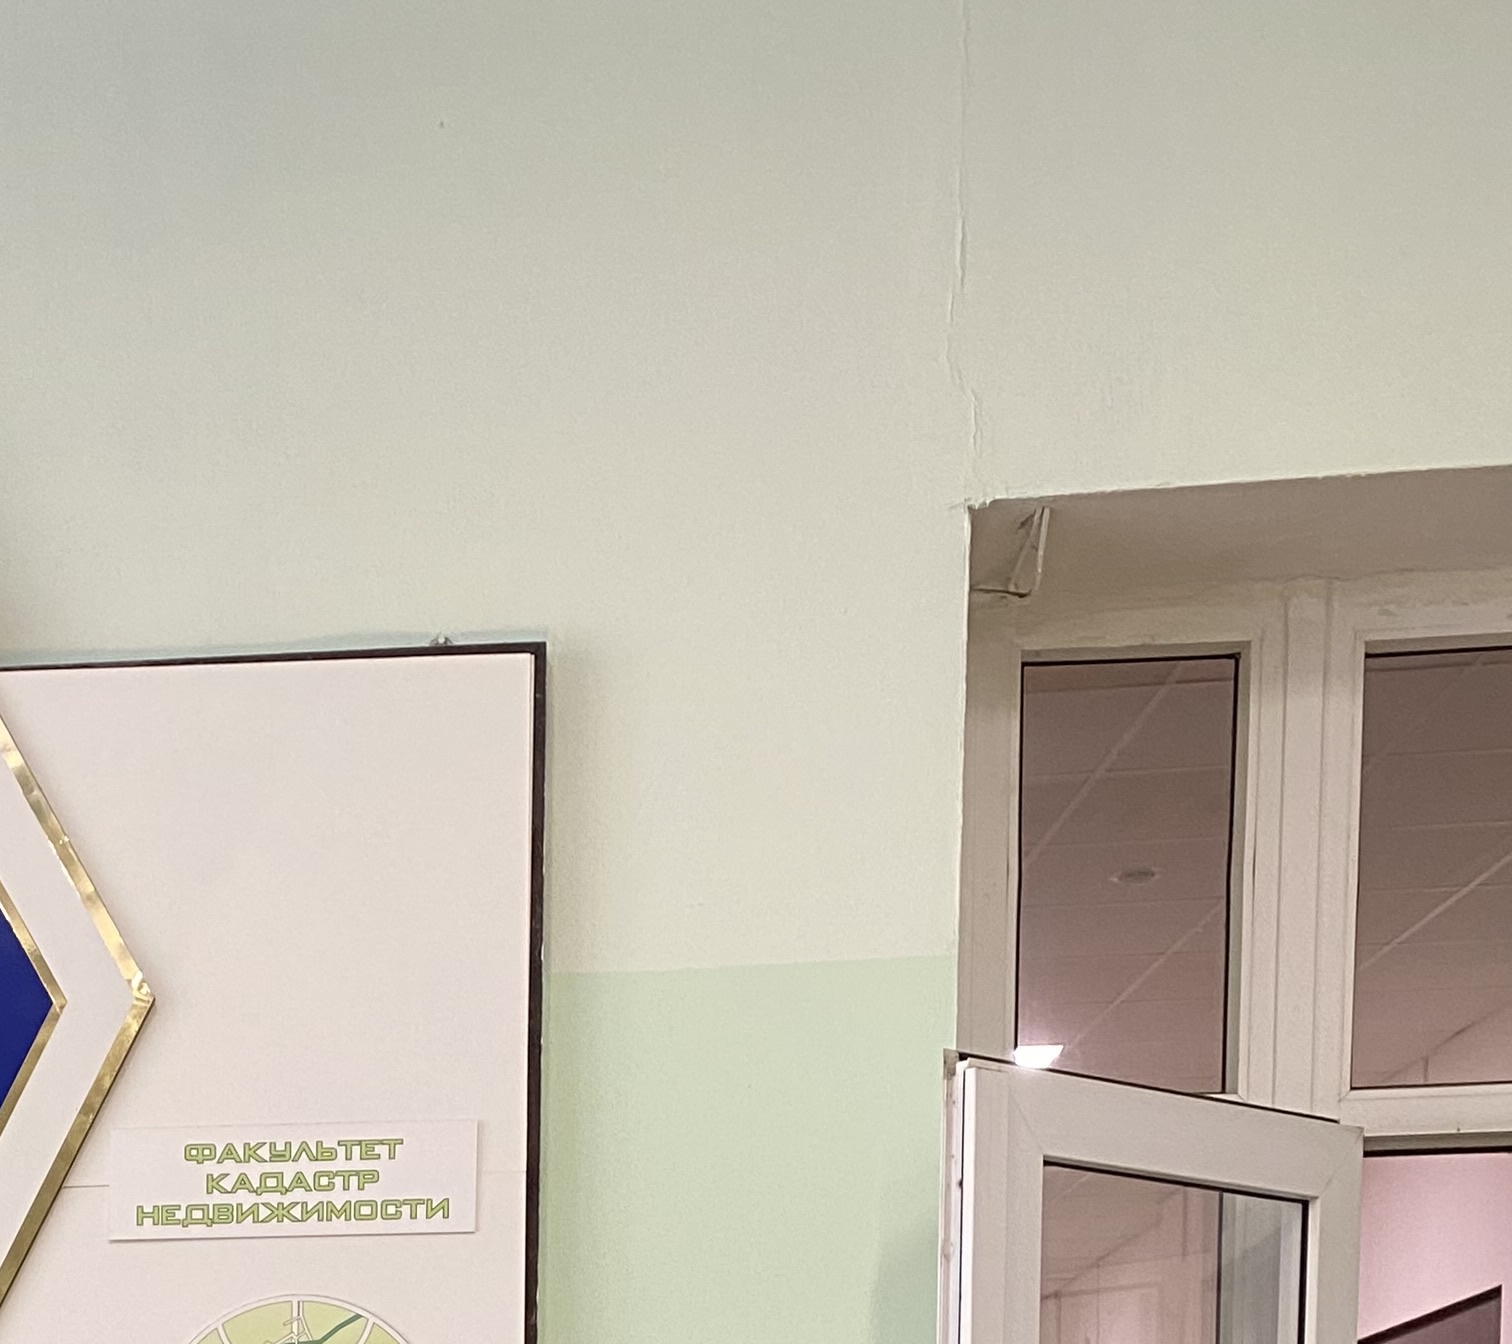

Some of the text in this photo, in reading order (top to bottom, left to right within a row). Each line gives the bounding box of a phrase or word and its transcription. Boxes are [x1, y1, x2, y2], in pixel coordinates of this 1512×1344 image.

[184, 1138, 404, 1164] ФАКУЛЬТЕТ
[206, 1169, 380, 1195] КАДАСТР
[136, 1198, 450, 1228] НЕДВИЖИМОСТИ
